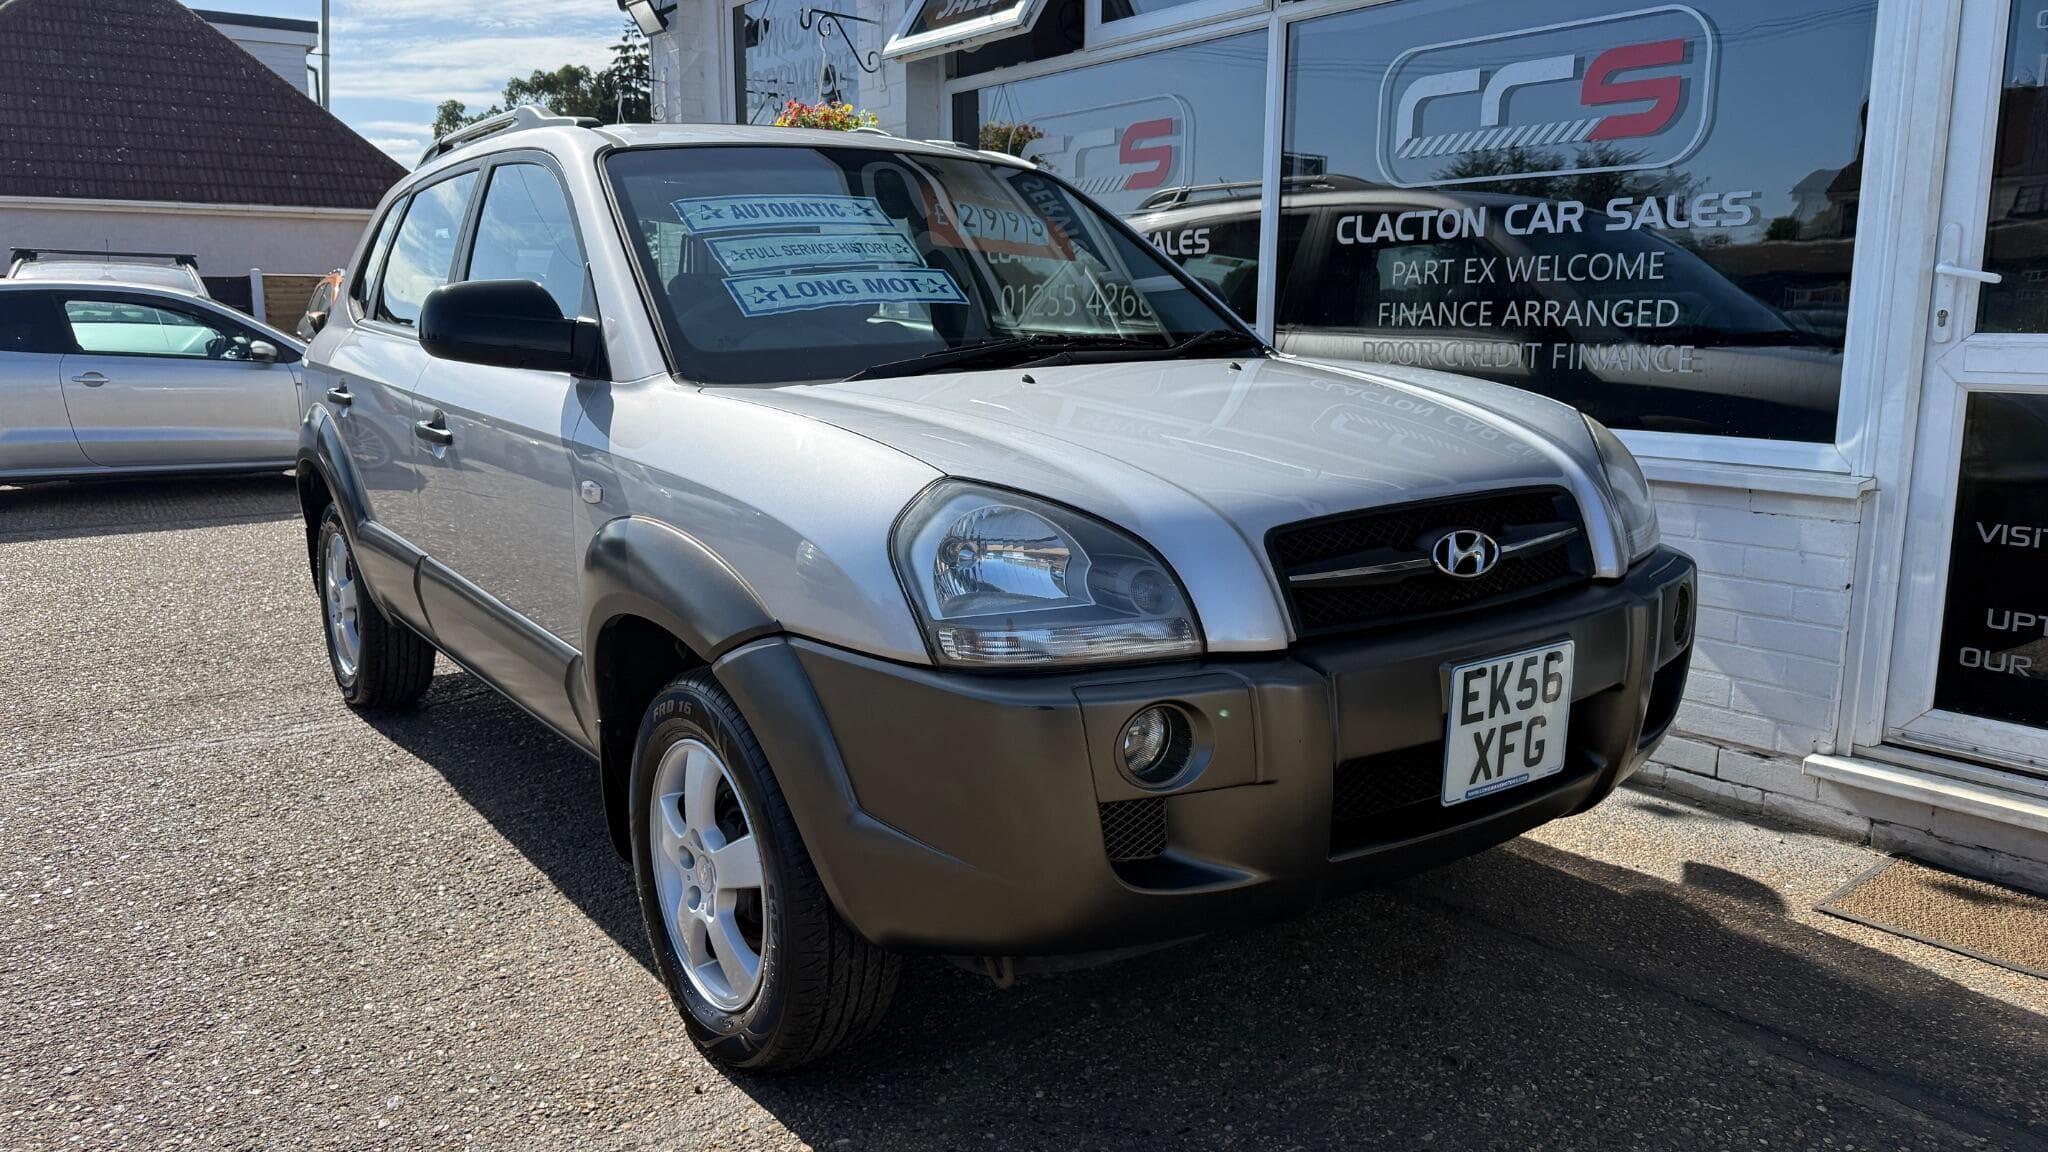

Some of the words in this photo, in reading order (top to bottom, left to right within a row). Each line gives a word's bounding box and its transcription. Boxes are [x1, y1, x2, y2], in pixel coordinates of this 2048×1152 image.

[730, 202, 846, 220] AUTOMATIC
[1336, 206, 1486, 245] CLACTON
[1504, 200, 1586, 235] CAR
[1605, 190, 1753, 232] SALES
[745, 246, 773, 260] FULL
[785, 242, 834, 257] SERVICE
[840, 241, 890, 255] HISTORY
[1149, 227, 1210, 257] ALES
[1392, 259, 1454, 286] PART
[1464, 256, 1496, 284] EX
[1506, 251, 1665, 283] WELCOME
[777, 278, 857, 300] LONG
[861, 277, 921, 295] MOT
[1001, 283, 1077, 318] 01255
[1378, 301, 1492, 328] FINANCE
[1501, 299, 1680, 328] ARRANGED
[1443, 340, 1543, 369] CREDIT
[1552, 342, 1696, 374] FINANCE
[1960, 646, 2032, 677] OUR
[1461, 651, 1564, 726] EK56
[1469, 715, 1547, 785] XFG
